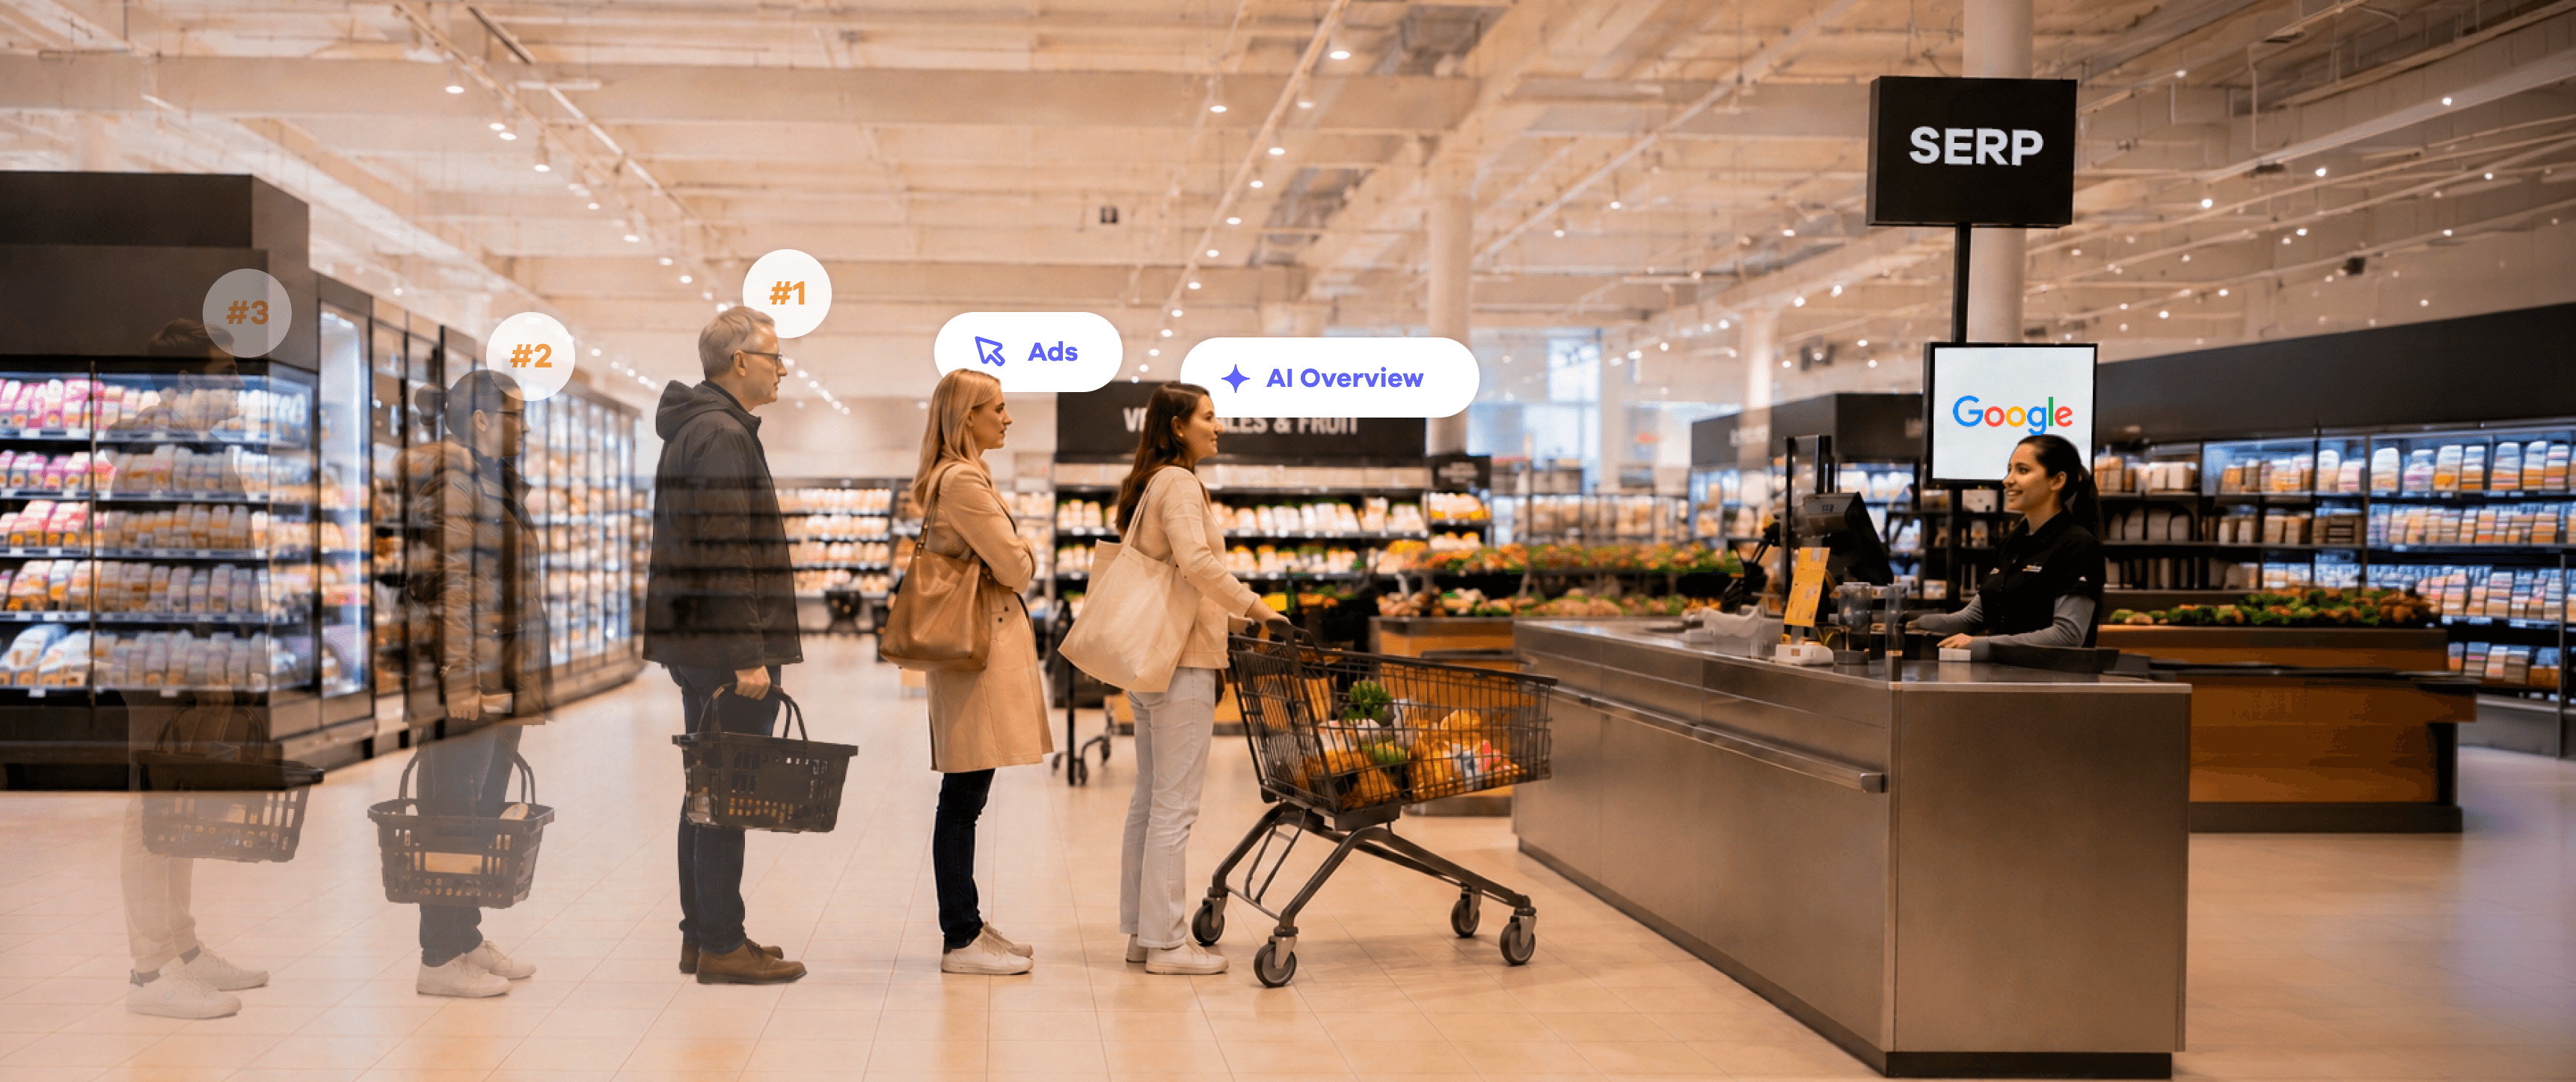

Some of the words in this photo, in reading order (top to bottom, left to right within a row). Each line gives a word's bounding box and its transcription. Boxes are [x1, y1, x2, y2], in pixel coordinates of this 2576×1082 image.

[1910, 126, 2044, 166] SERP
[1273, 417, 1292, 434] &
[1297, 417, 1358, 435] FRUIT
[1952, 394, 2073, 436] Google
